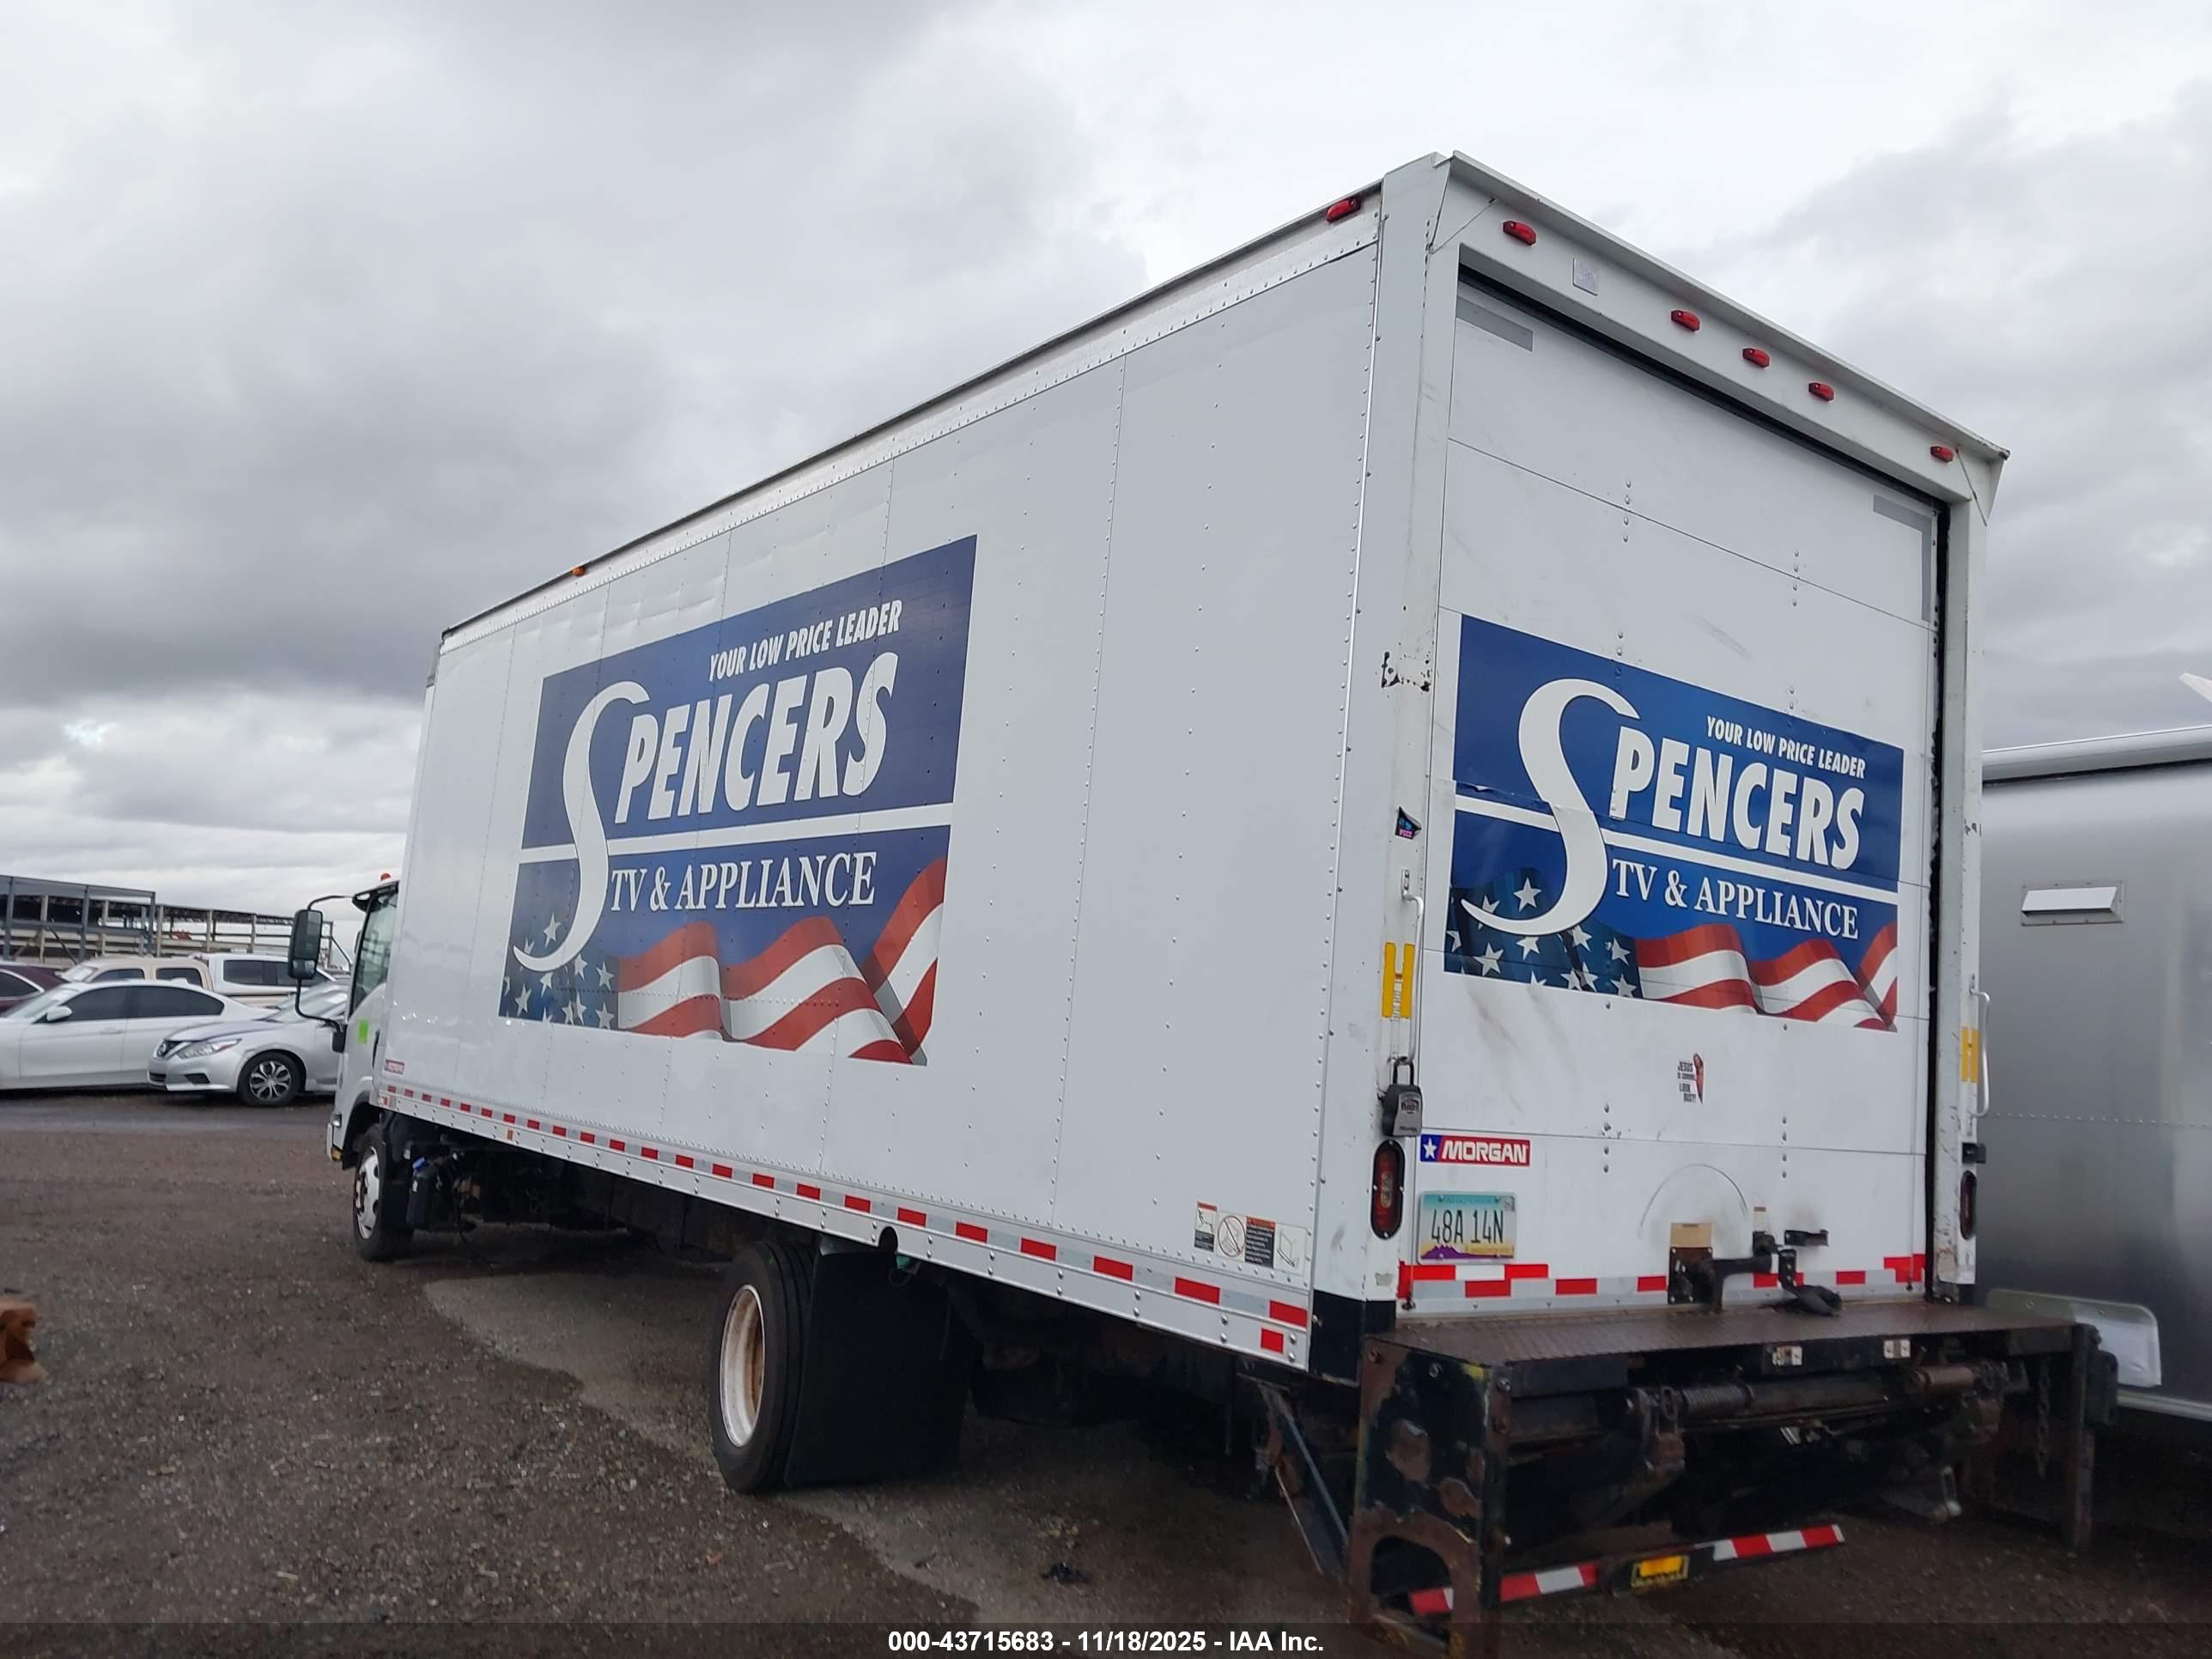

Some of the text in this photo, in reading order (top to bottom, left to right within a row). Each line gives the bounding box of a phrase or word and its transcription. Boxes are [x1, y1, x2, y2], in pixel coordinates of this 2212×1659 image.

[708, 599, 902, 682] YOUR LOW PRICE LEADER
[1706, 714, 1866, 780] YOUR LOW PRICE LEADER
[514, 652, 900, 972] SPENCERS
[1460, 678, 1865, 936] SPENCERS
[611, 851, 878, 912] TV & APPLIANCE
[1612, 858, 1859, 940] TV & APPLIANCE
[1442, 1139, 1528, 1164] MORGAN
[1431, 1209, 1504, 1244] 48A 14N
